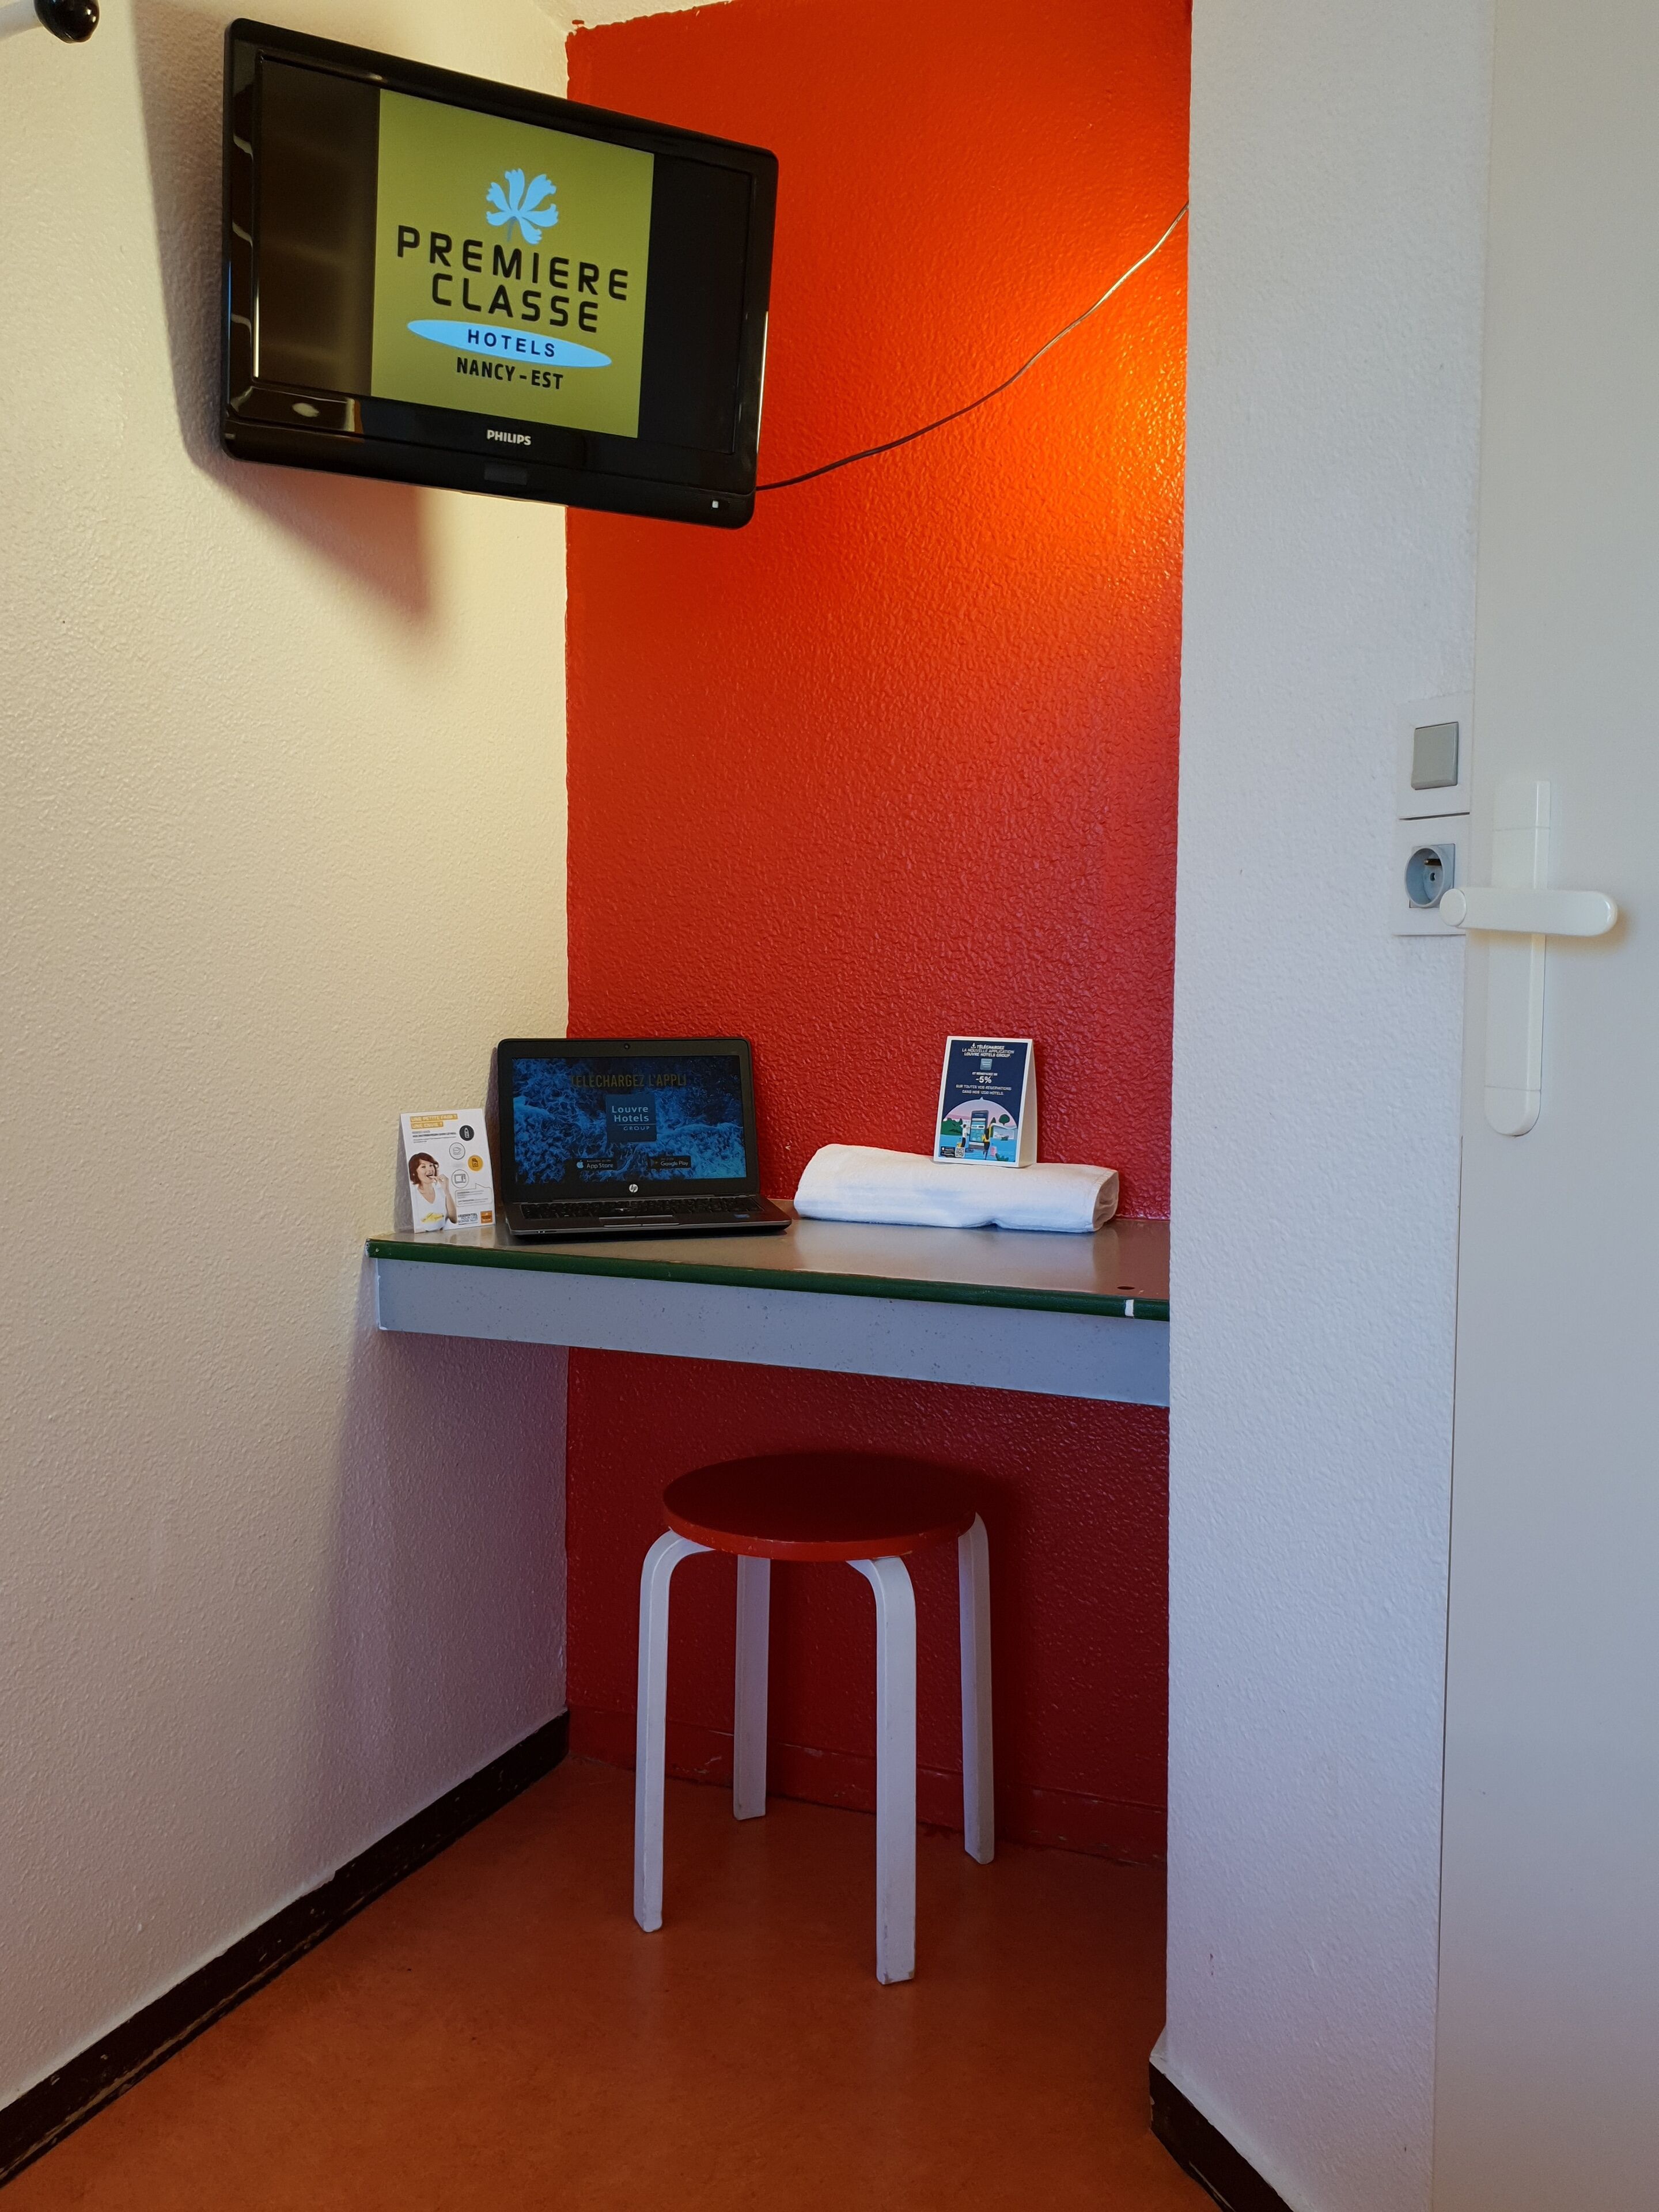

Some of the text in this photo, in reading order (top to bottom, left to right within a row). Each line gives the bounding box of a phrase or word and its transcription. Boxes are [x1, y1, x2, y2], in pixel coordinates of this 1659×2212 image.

[397, 225, 628, 301] PREMIERE
[432, 273, 598, 333] CLASSE
[468, 329, 555, 357] HOTELS
[487, 429, 531, 446] PHILIPS
[614, 1114, 649, 1122] Hotels
[630, 1184, 638, 1192] hp
